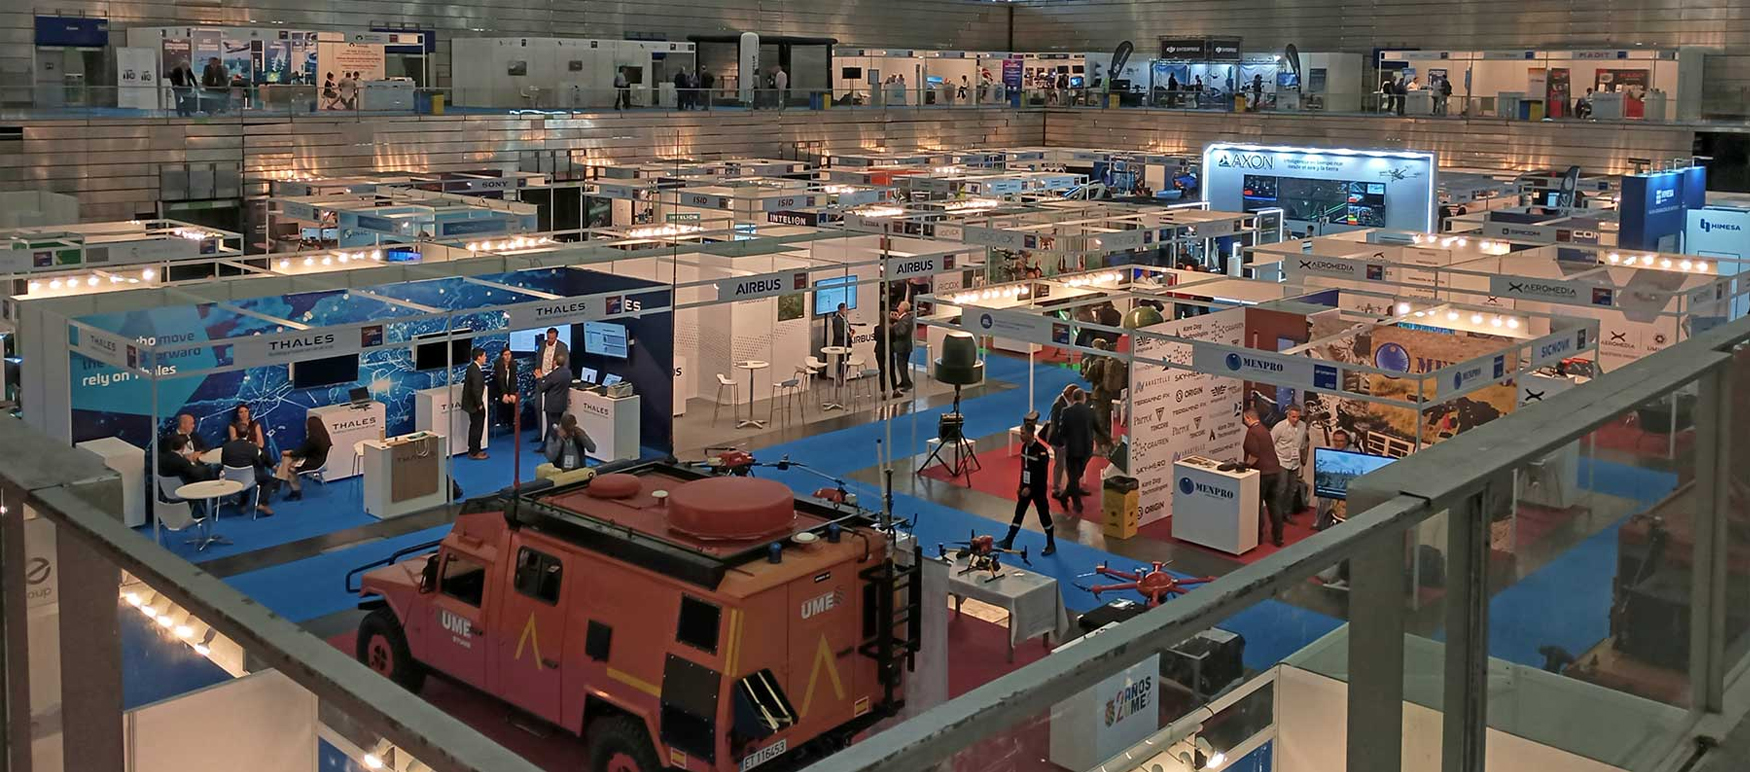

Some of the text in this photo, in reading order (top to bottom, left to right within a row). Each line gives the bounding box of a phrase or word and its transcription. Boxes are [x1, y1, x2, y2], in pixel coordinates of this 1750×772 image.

[1231, 154, 1275, 170] AXON
[482, 181, 508, 189] SONY
[770, 214, 806, 226] INTELION
[897, 260, 933, 274] AIRBUS
[1311, 262, 1354, 272] AEROMEDIA
[735, 279, 781, 295] AIRBUS
[1524, 283, 1577, 295] AEROMEDIA
[536, 302, 586, 316] THALES
[90, 335, 116, 352] THALES
[136, 336, 156, 347] ho
[268, 334, 334, 350] THALES
[1243, 357, 1284, 372] MENPRO
[83, 373, 109, 387] rely
[112, 372, 129, 382] on
[1184, 386, 1203, 398] ORIGIN
[583, 402, 609, 416] THALES
[332, 417, 377, 430] THALES
[1195, 481, 1234, 499] MENPRO
[801, 593, 834, 618] UME
[442, 610, 472, 638] UME
